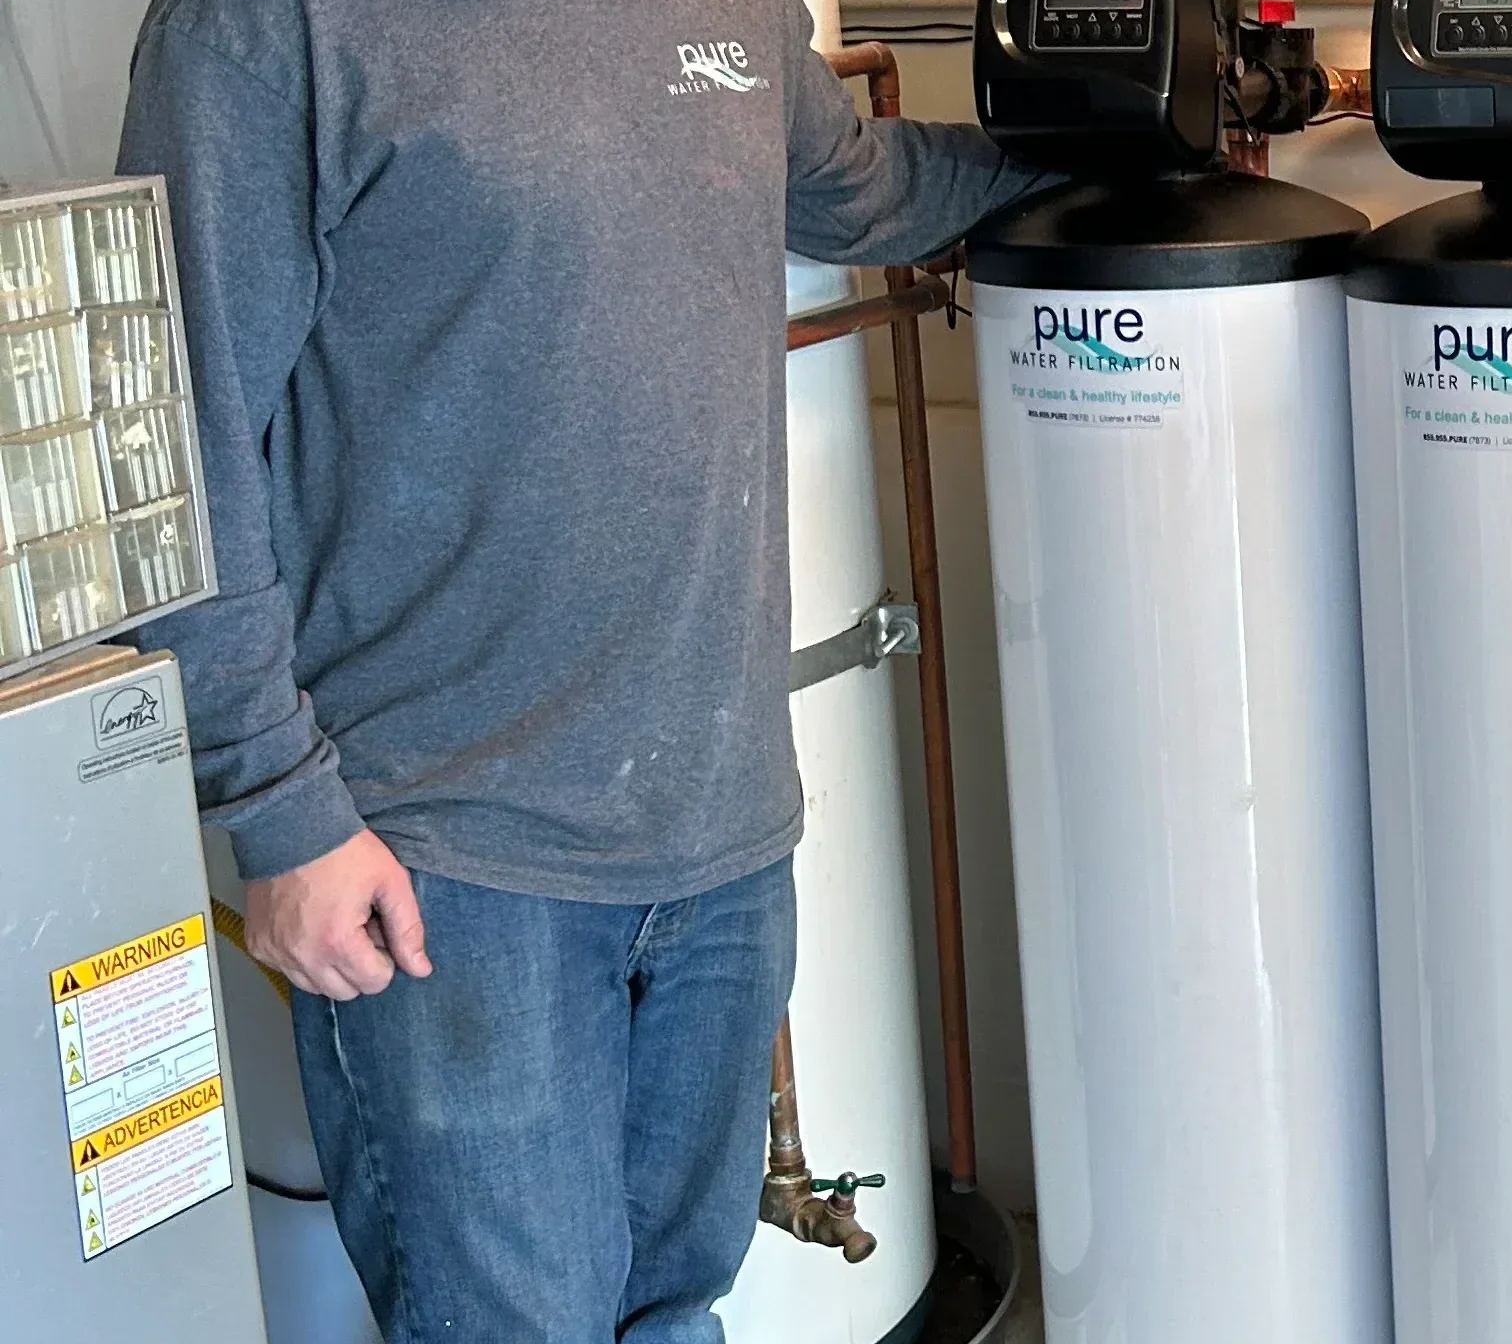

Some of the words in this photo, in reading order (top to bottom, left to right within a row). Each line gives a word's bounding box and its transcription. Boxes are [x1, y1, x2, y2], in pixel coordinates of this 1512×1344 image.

[677, 41, 748, 80] pure
[667, 80, 710, 96] WATER
[1034, 305, 1143, 350] pure
[1010, 351, 1057, 369] WATER
[1069, 356, 1180, 372] FILTRATION
[1404, 369, 1458, 390] WATER
[1037, 386, 1066, 400] clean
[1070, 389, 1078, 401] &
[1082, 389, 1127, 404] healthy
[1131, 390, 1181, 404] lifestyle
[1405, 407, 1421, 419] For
[1425, 410, 1431, 421] a
[1434, 410, 1466, 423] clean
[1471, 412, 1480, 423] &
[92, 927, 186, 980] WARNING
[104, 1084, 219, 1152] ADVERTENCIA
